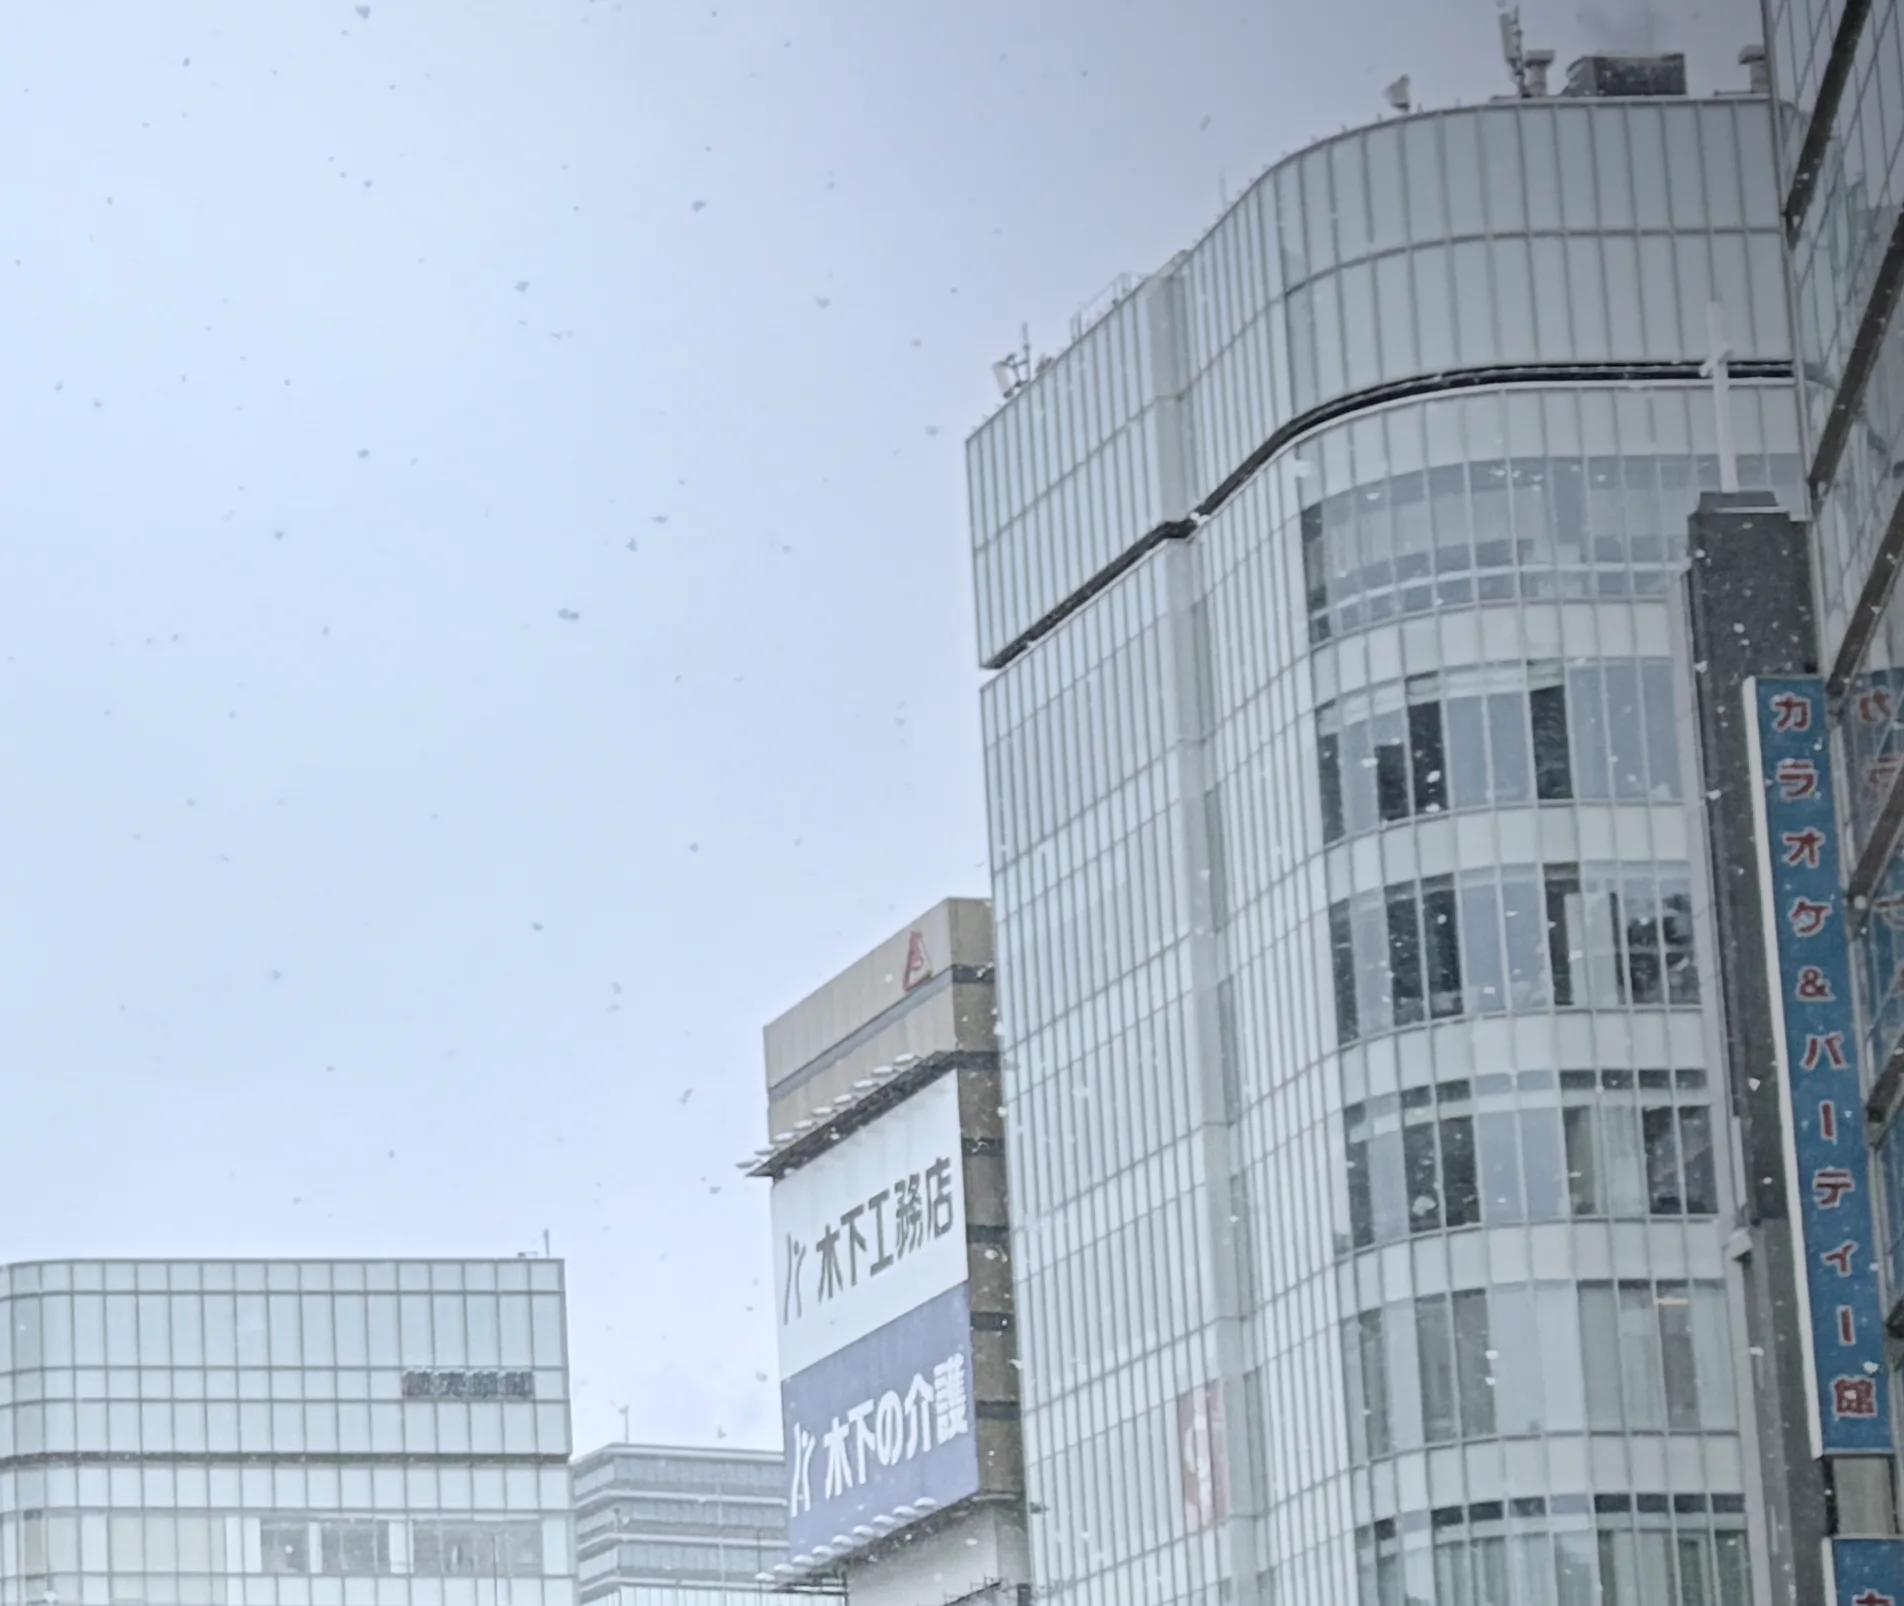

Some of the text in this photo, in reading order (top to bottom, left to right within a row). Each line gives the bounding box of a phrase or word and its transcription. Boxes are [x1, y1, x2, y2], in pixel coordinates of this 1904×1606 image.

[814, 1154, 954, 1303] 木下工務店
[823, 1352, 970, 1499] 木下の介護
